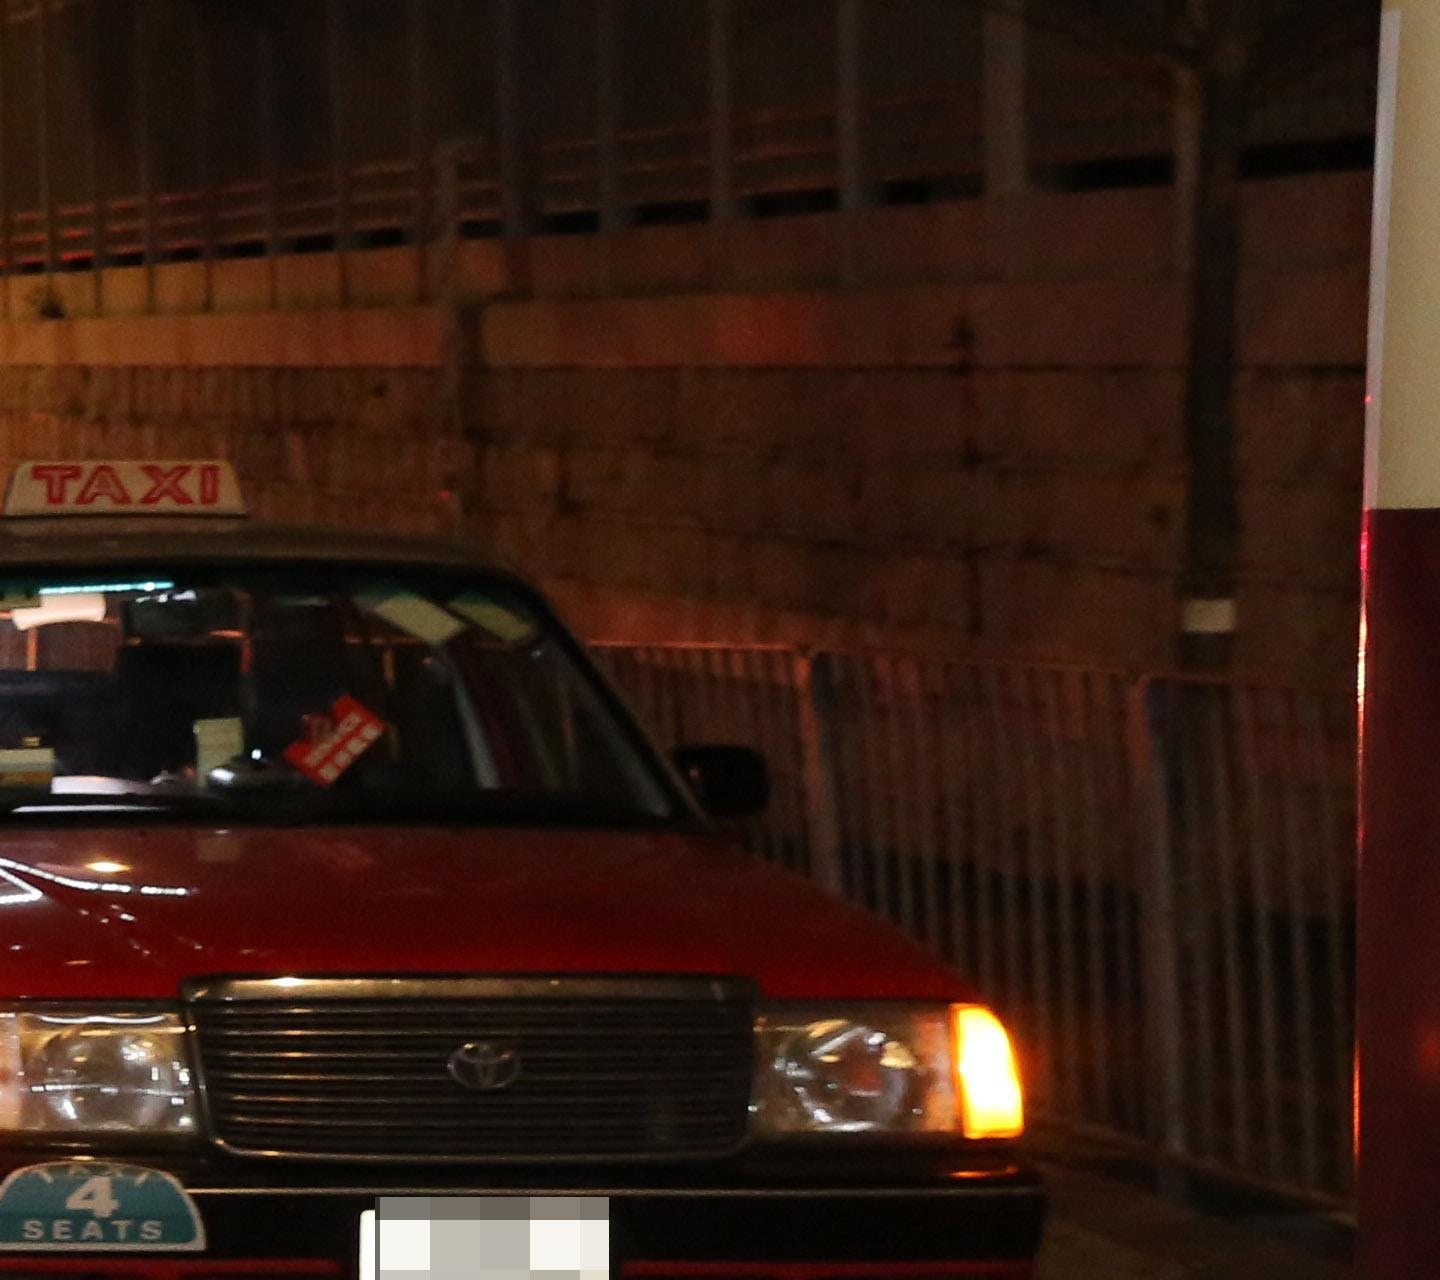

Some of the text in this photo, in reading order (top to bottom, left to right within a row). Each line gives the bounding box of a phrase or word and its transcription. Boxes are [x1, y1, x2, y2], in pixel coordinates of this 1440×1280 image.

[32, 465, 221, 505] TAXI
[64, 1175, 120, 1219] 4
[22, 1219, 164, 1241] SEATS
